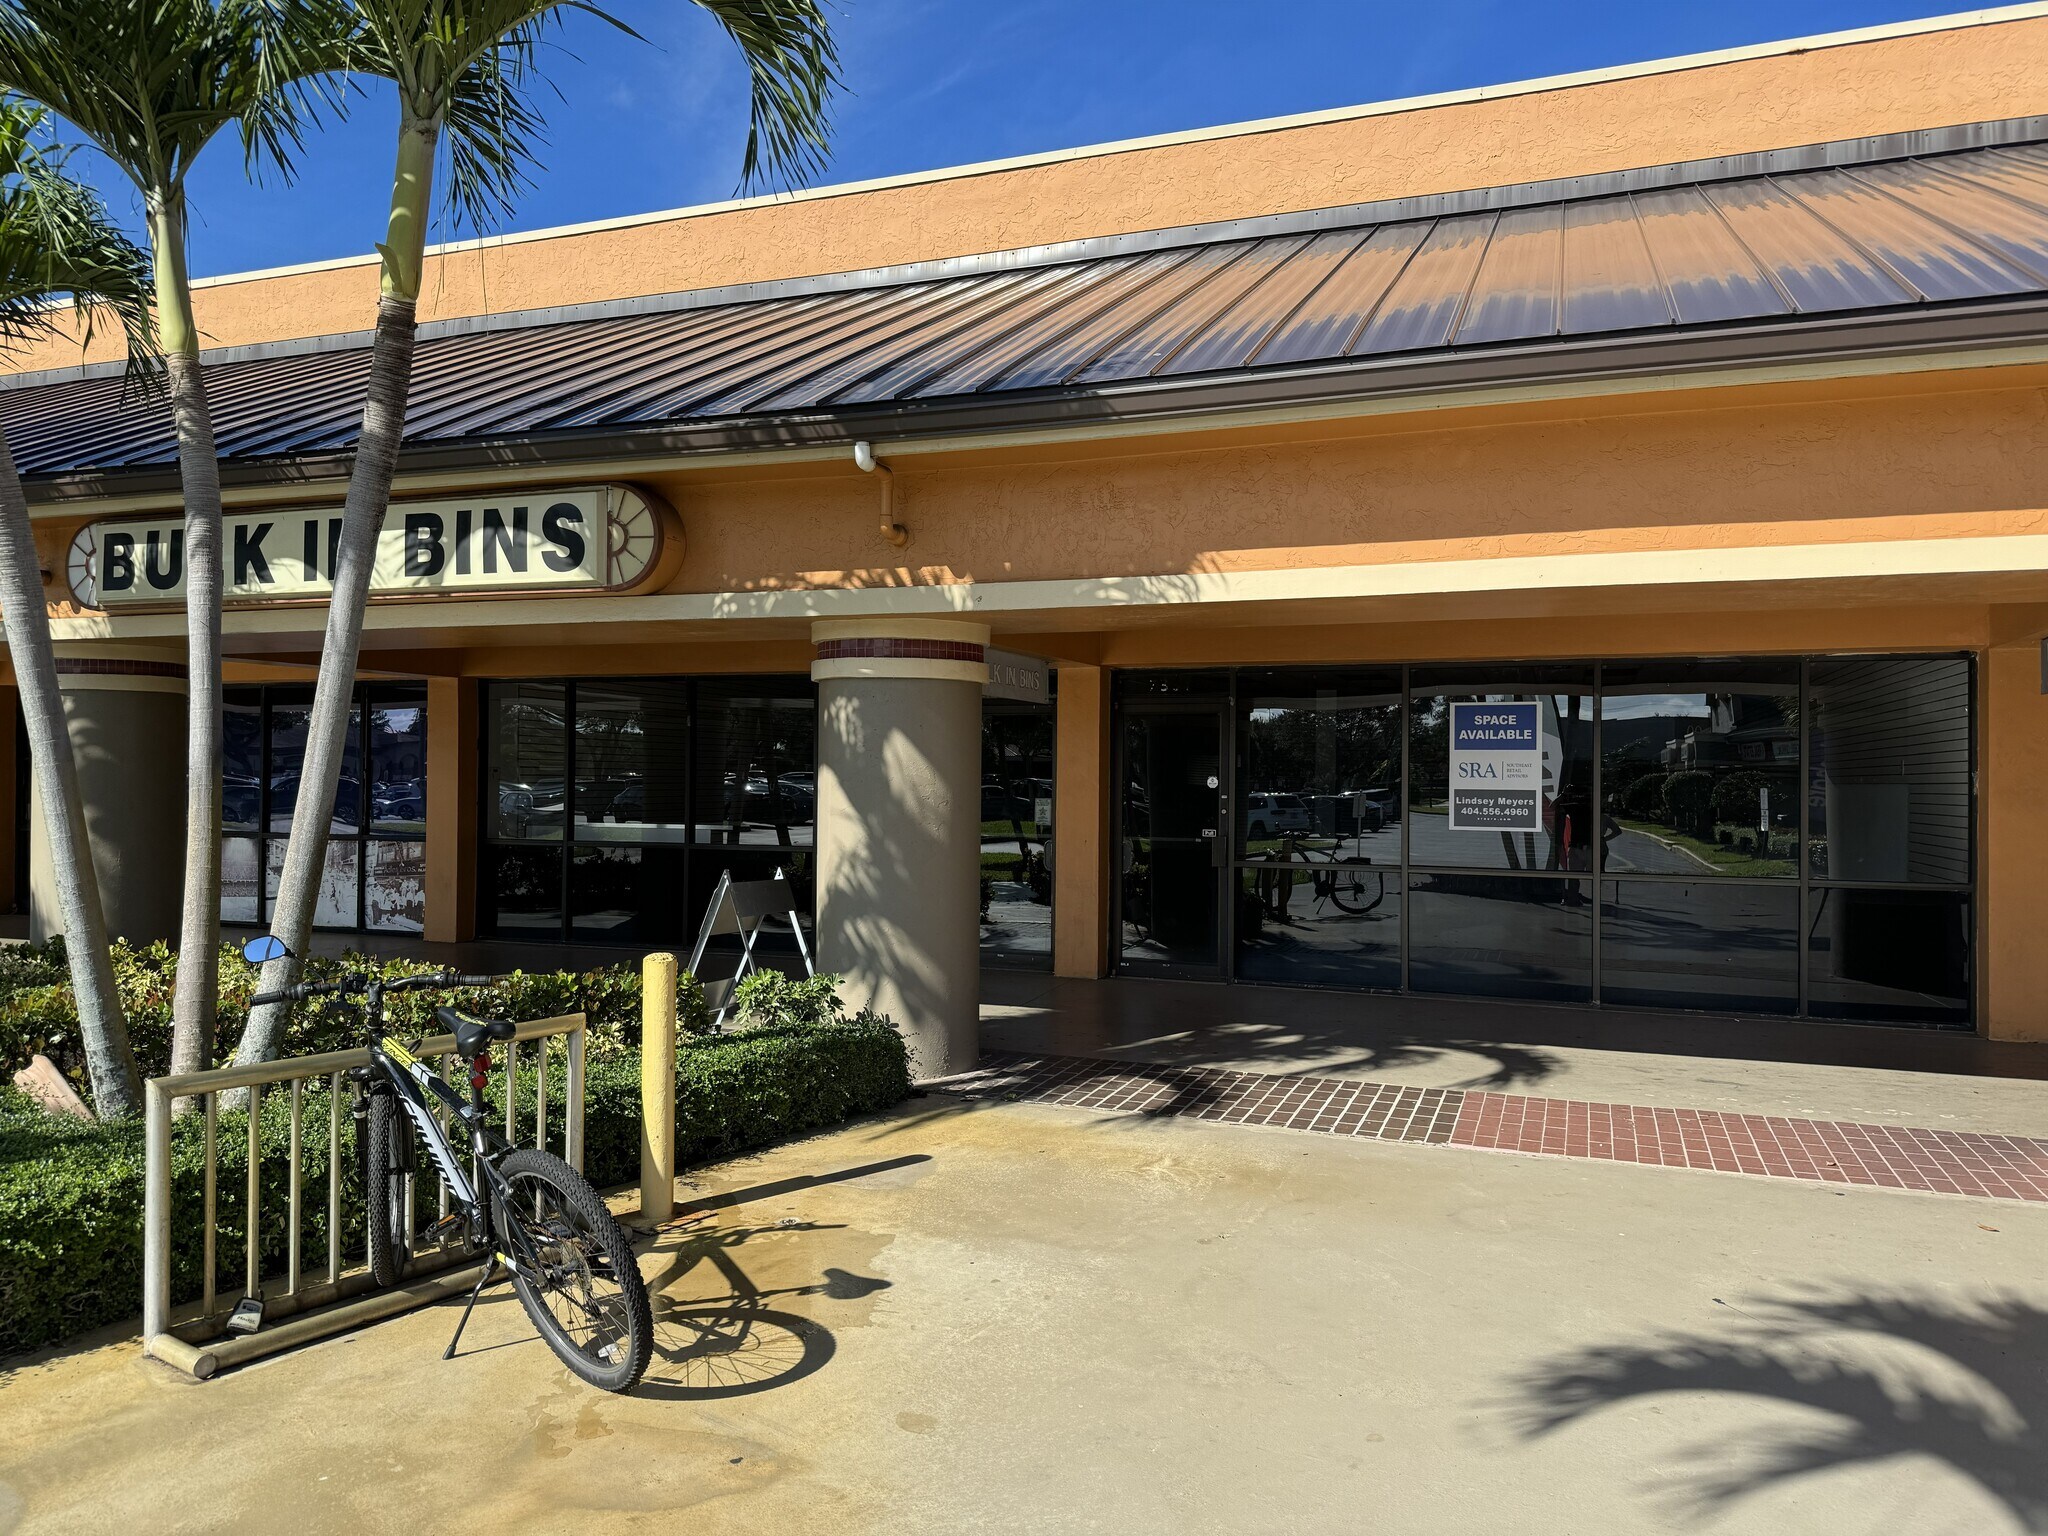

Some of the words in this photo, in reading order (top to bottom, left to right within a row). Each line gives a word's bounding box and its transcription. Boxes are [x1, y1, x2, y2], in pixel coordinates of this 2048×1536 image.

[103, 523, 275, 591] BUK
[404, 502, 585, 578] BINS
[1006, 665, 1016, 686] IN
[1019, 669, 1040, 690] BINS
[1474, 715, 1517, 725] SPACE
[1459, 729, 1532, 740] AVAILABLE
[1458, 762, 1497, 778] SRA
[1456, 796, 1495, 806] Lindsey
[1497, 797, 1535, 807] Meyers
[1460, 807, 1529, 816] 404.556.4960
